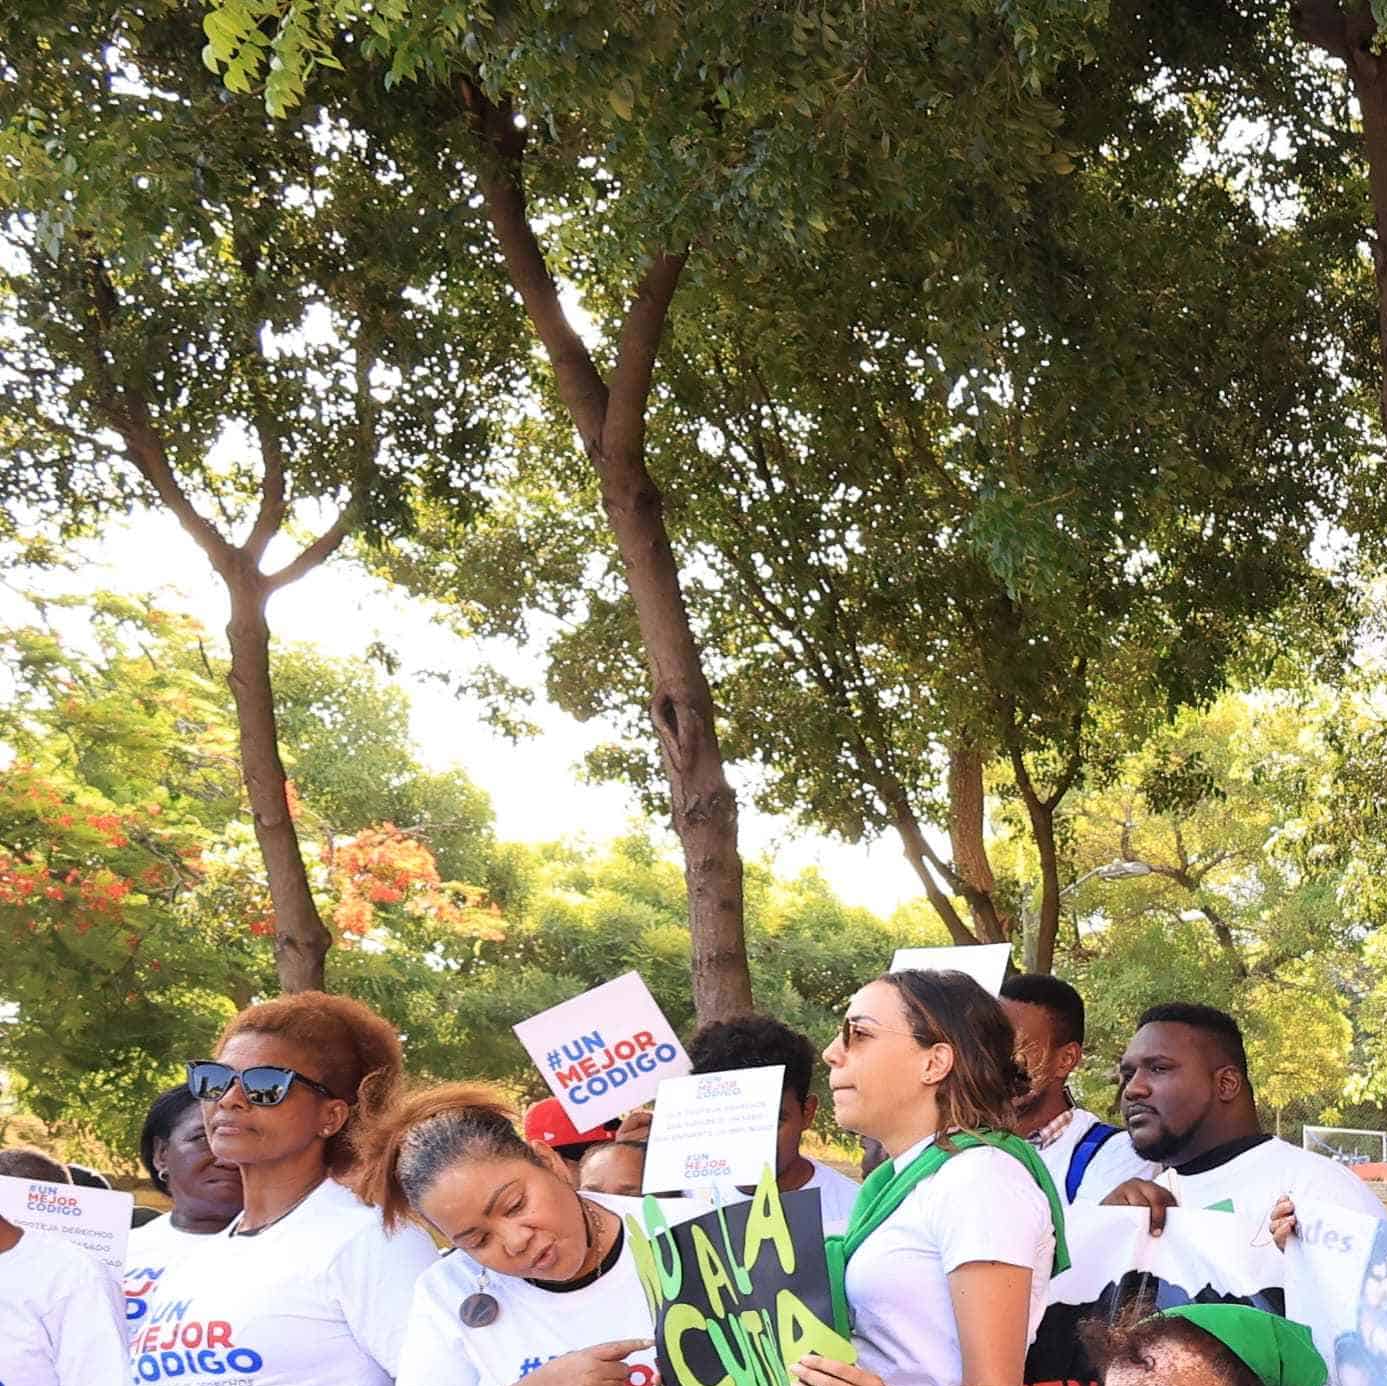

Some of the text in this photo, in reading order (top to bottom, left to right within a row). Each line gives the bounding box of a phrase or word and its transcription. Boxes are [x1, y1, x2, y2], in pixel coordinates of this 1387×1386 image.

[547, 1030, 606, 1072] #UN
[555, 1031, 658, 1090] MEJOR
[568, 1043, 678, 1105] CODIGO
[27, 1193, 78, 1207] MEJOR
[29, 1183, 58, 1195] #UN
